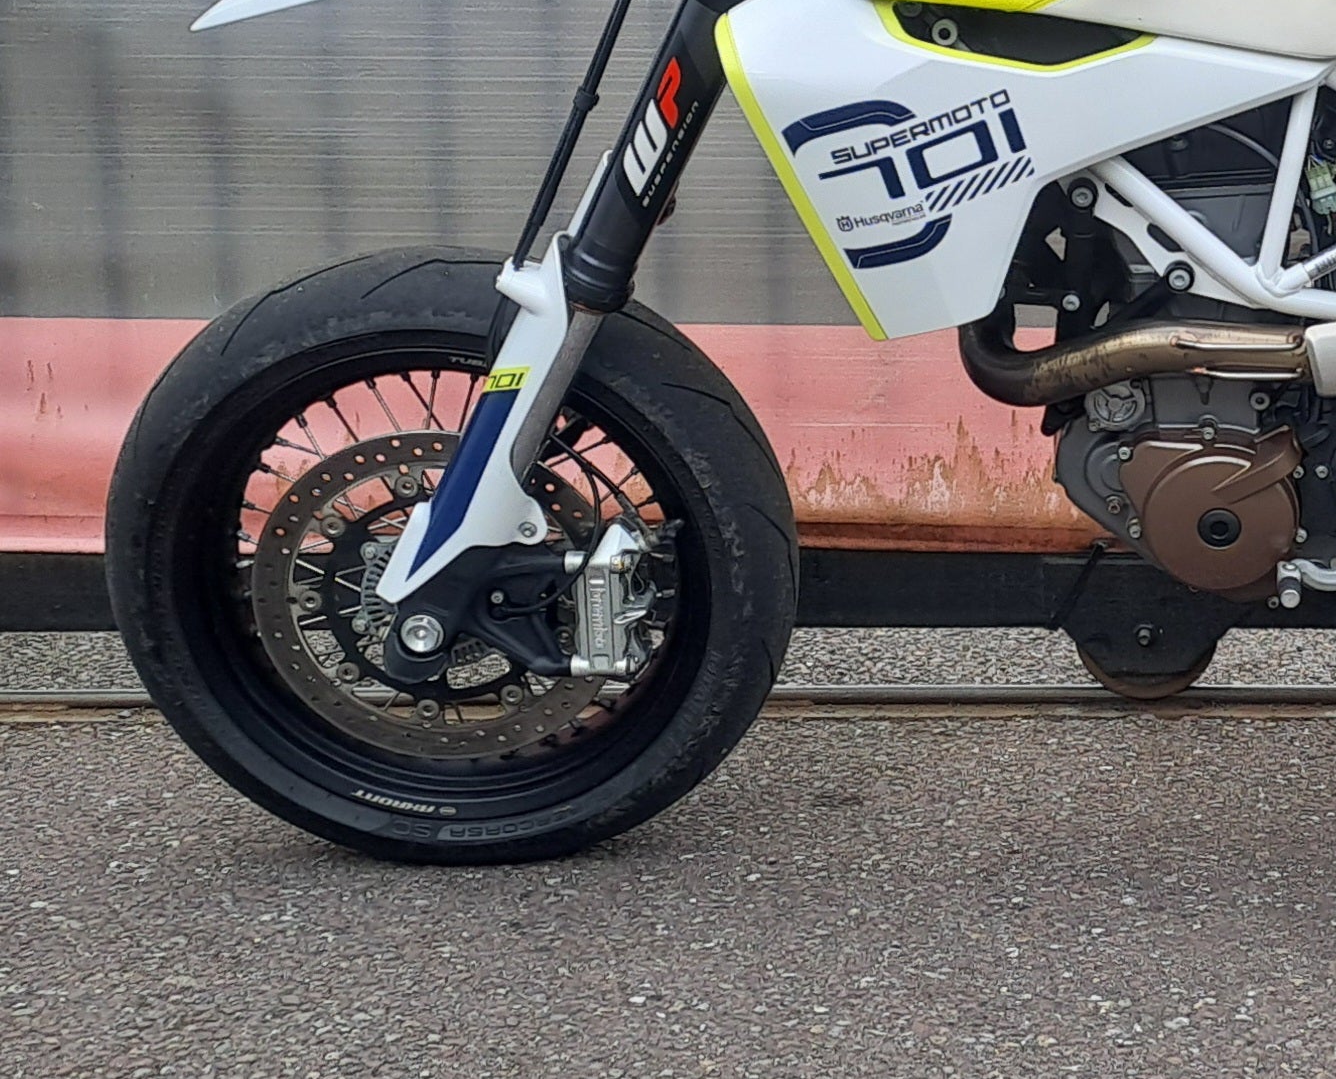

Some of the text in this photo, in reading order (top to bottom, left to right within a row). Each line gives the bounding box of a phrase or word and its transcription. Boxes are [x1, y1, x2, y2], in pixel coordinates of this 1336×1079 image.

[818, 108, 1027, 199] 701
[830, 88, 1010, 165] SUPERMOTO
[854, 202, 924, 228] Husqvarna
